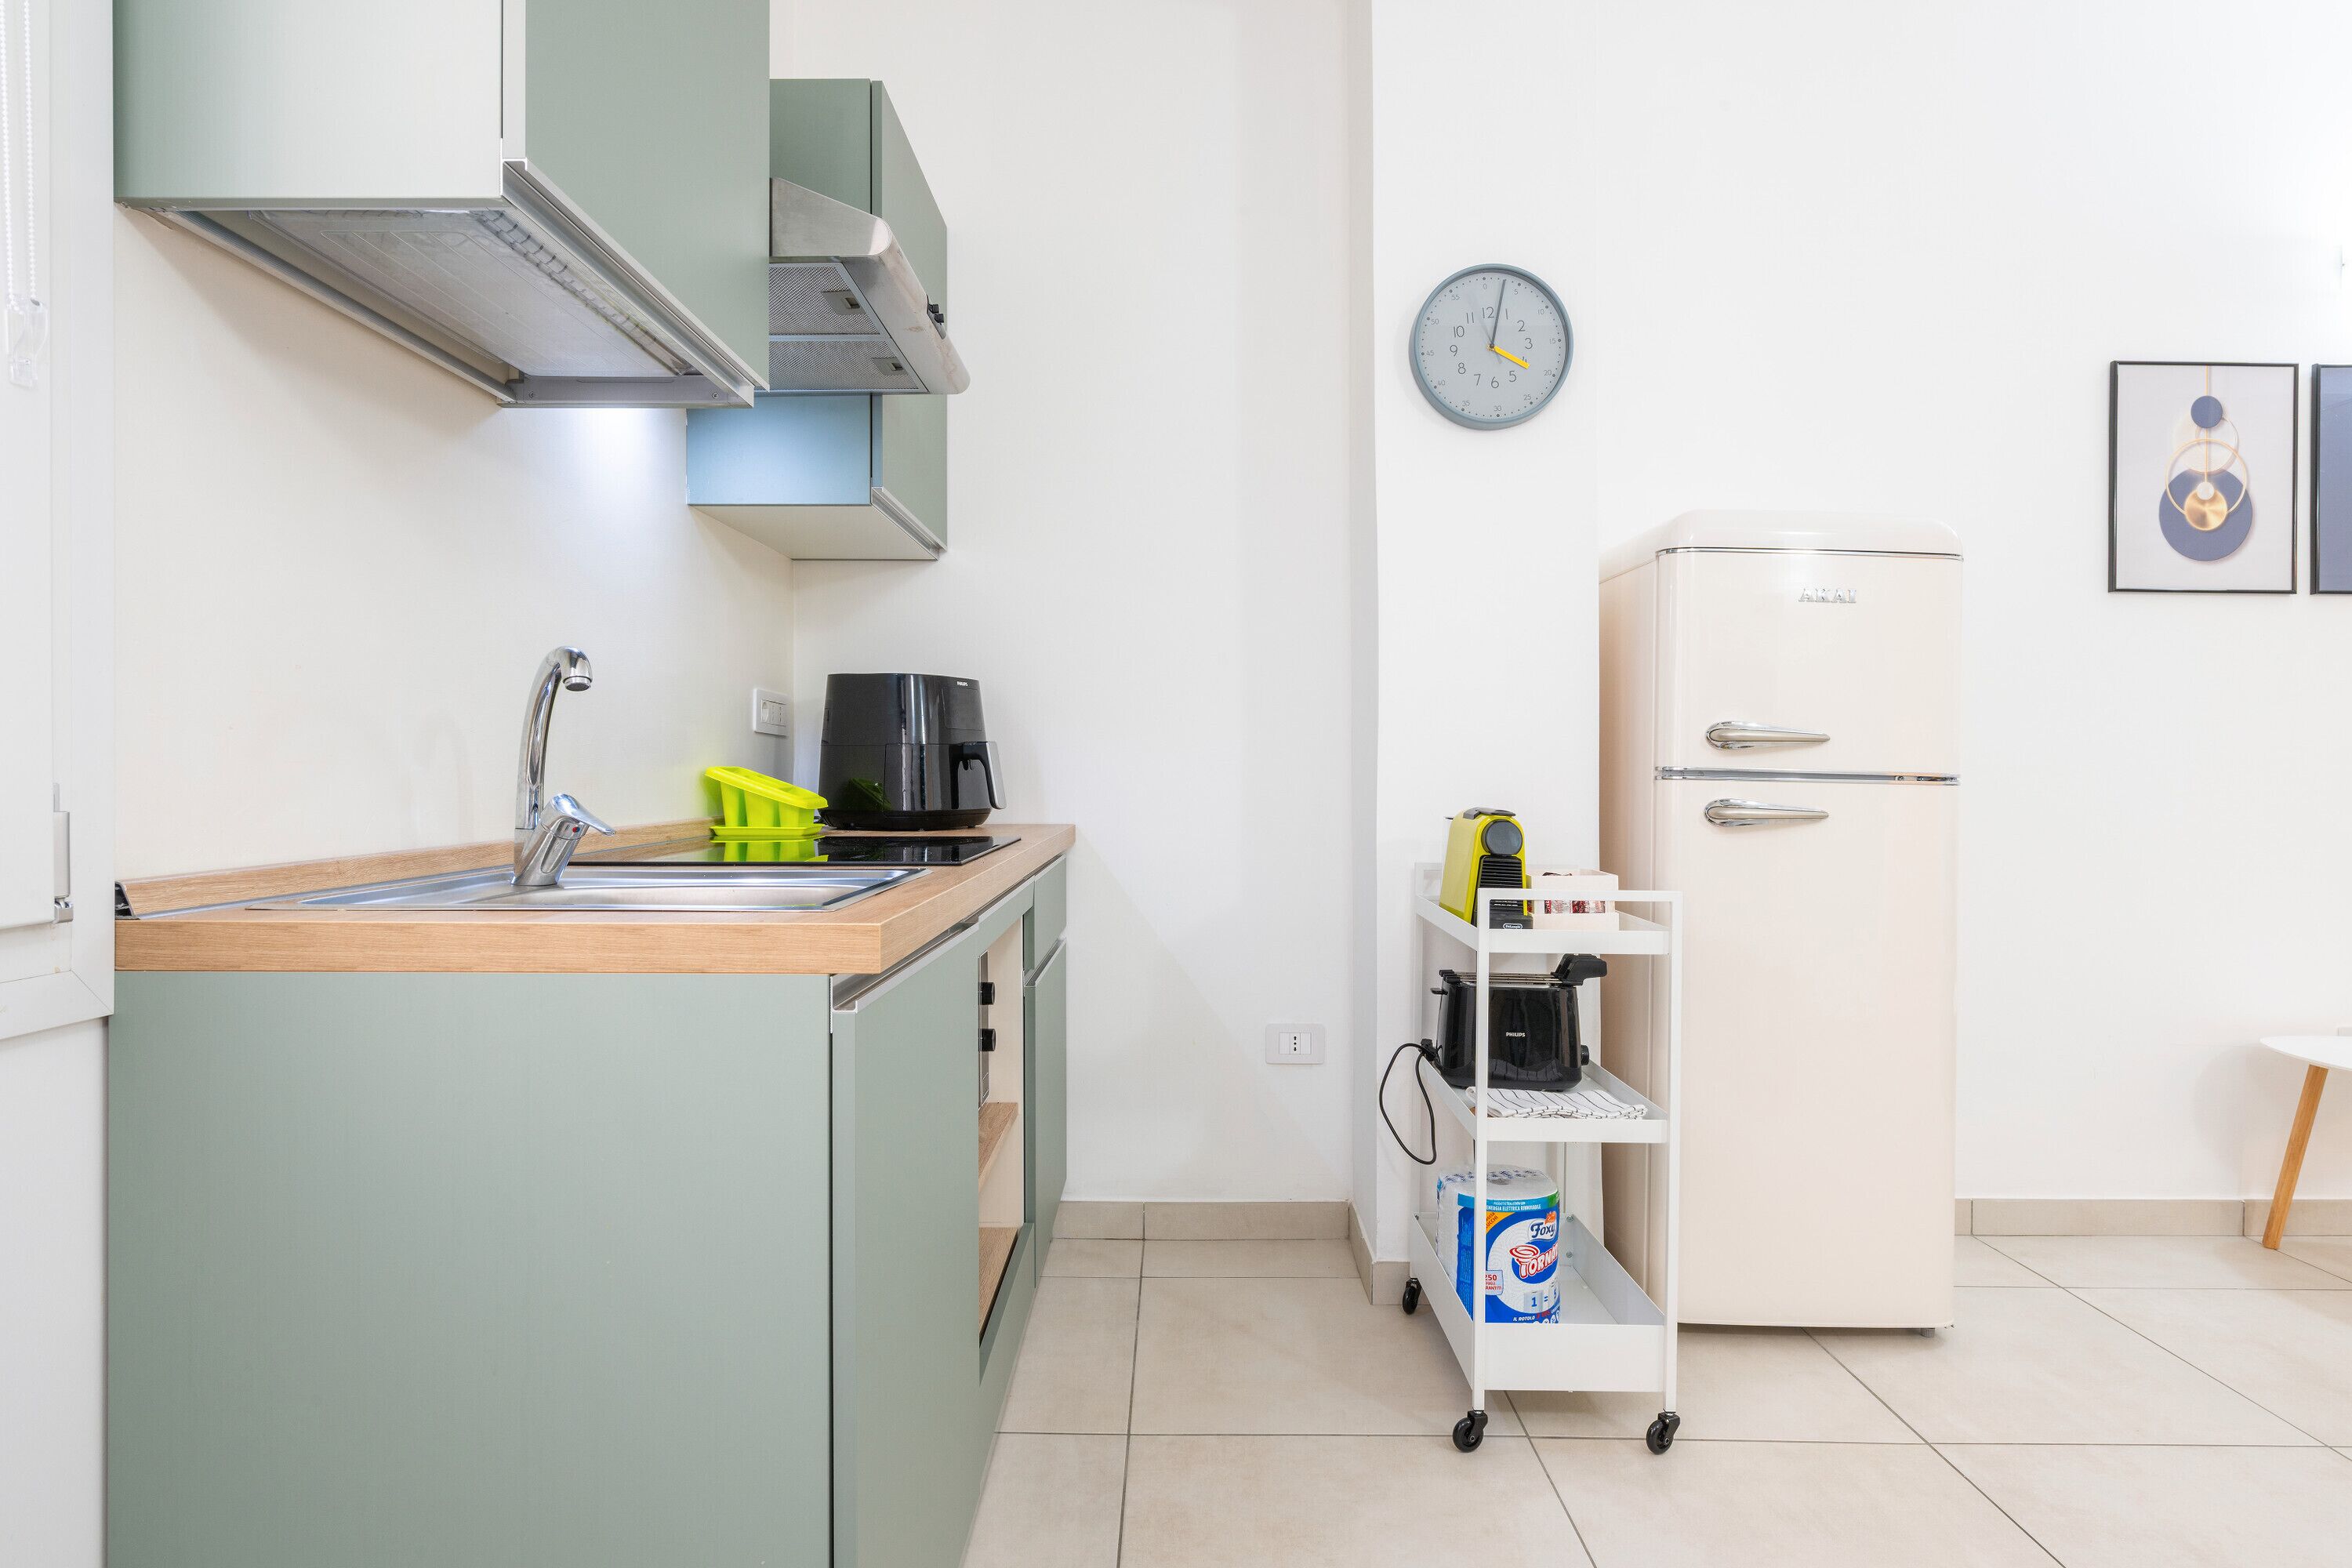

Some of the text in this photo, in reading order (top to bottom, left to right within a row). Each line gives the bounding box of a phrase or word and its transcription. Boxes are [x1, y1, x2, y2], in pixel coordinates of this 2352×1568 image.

[1466, 312, 1474, 324] 11
[1482, 307, 1494, 318] 12
[1454, 325, 1465, 338] 10
[1517, 320, 1526, 332] 2
[1524, 338, 1533, 349] 3
[1450, 345, 1458, 357] 9
[1458, 362, 1466, 374] 8
[1474, 374, 1481, 386] 7
[1491, 376, 1499, 388] 6
[1508, 371, 1516, 382] 5
[1798, 588, 1857, 604] AKAI
[1530, 1221, 1555, 1238] Foxy
[1531, 1297, 1537, 1307] 1
